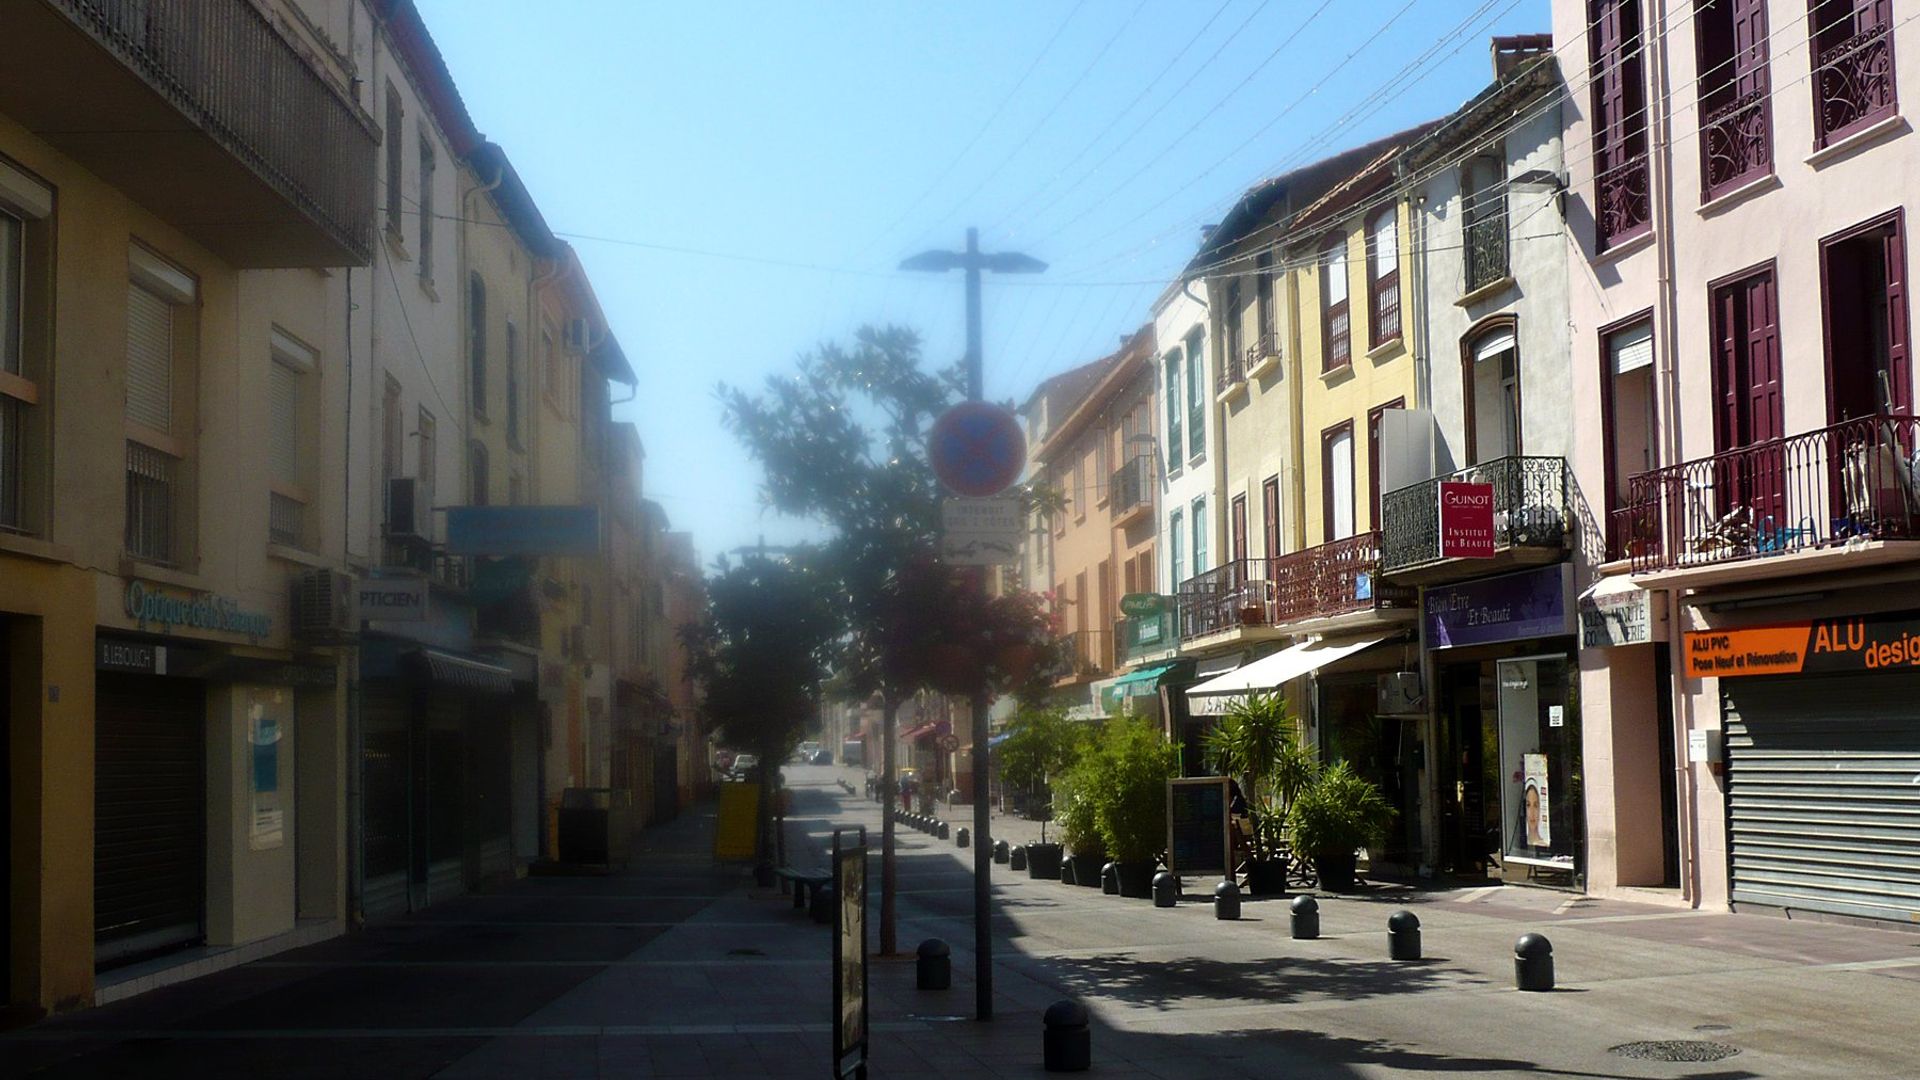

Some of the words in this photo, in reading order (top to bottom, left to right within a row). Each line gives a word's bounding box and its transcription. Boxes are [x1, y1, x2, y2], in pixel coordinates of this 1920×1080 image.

[1445, 491, 1489, 505] GUINOT
[1449, 528, 1488, 537] INSTITUT
[1445, 540, 1455, 548] DE
[127, 578, 190, 636] Optique
[357, 592, 420, 607] PTICIEN
[1428, 597, 1447, 615] Bien
[1814, 618, 1865, 653] ALU
[1692, 638, 1708, 652] ALU
[1711, 636, 1729, 650] PVC
[1693, 657, 1713, 671] Pose
[1715, 656, 1734, 669] Neuf
[1736, 654, 1744, 667] et
[1747, 650, 1797, 666] Rénovation
